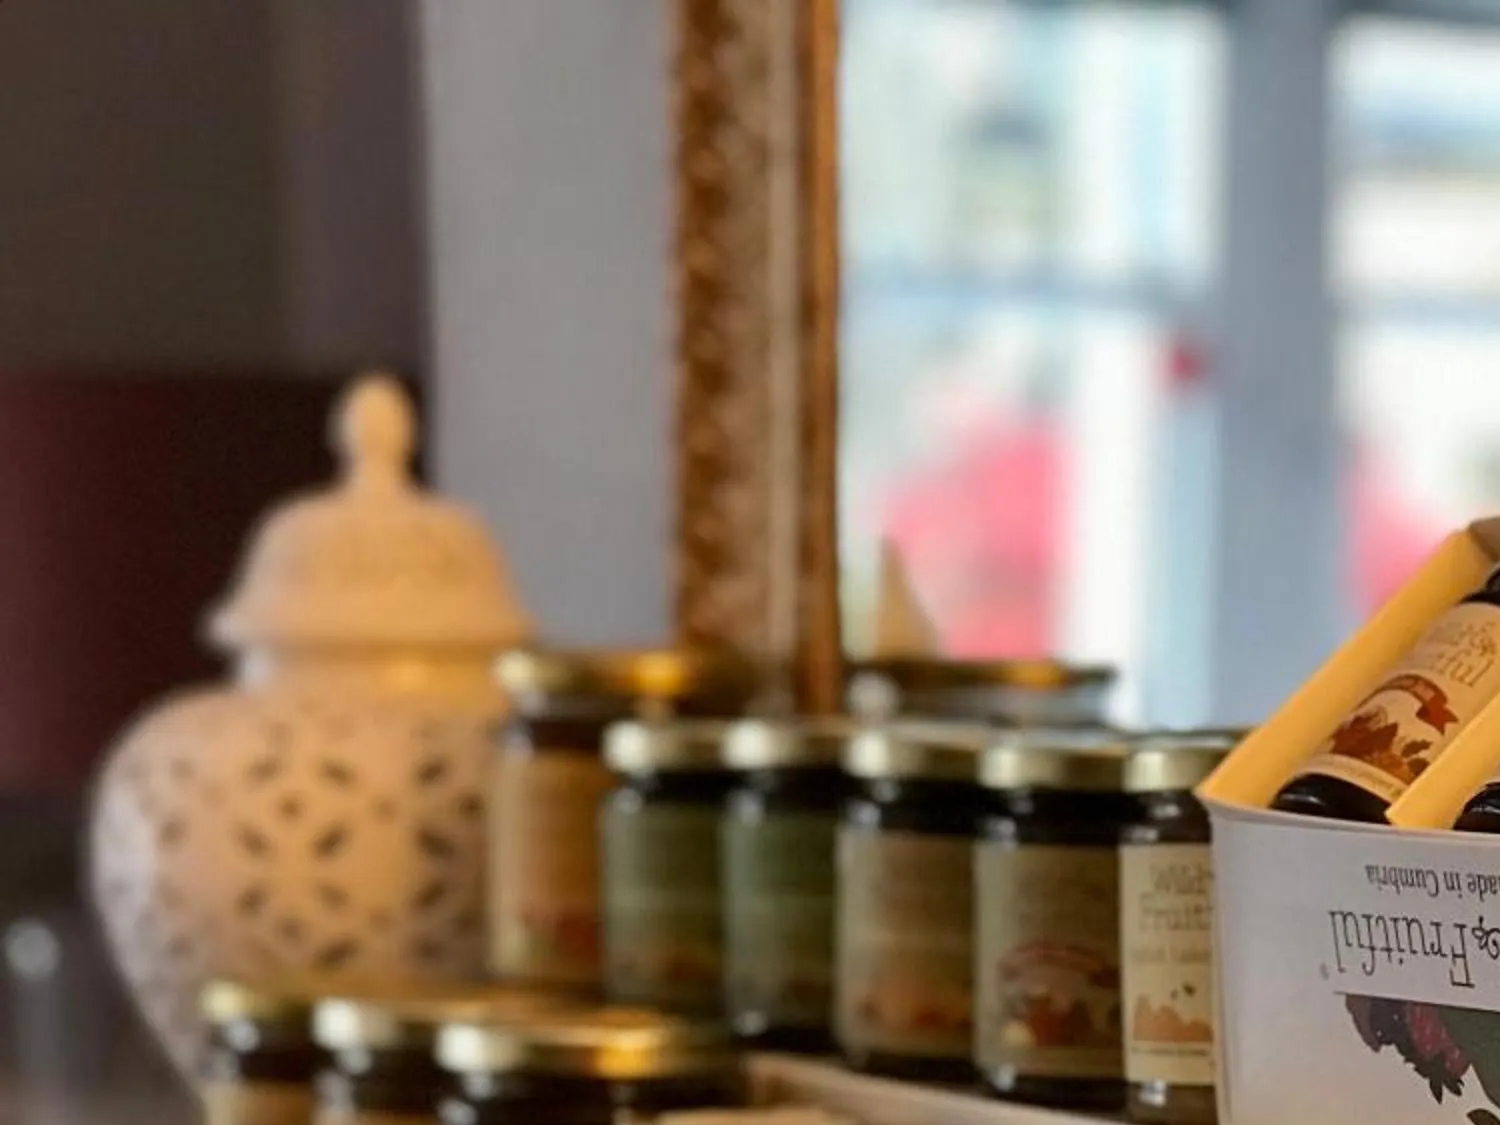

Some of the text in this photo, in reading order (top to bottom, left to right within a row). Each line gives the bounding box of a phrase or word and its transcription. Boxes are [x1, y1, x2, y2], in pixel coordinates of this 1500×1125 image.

[1365, 865, 1439, 897] Cumbria
[1444, 871, 1462, 899] in
[1329, 910, 1475, 988] Fruitful
